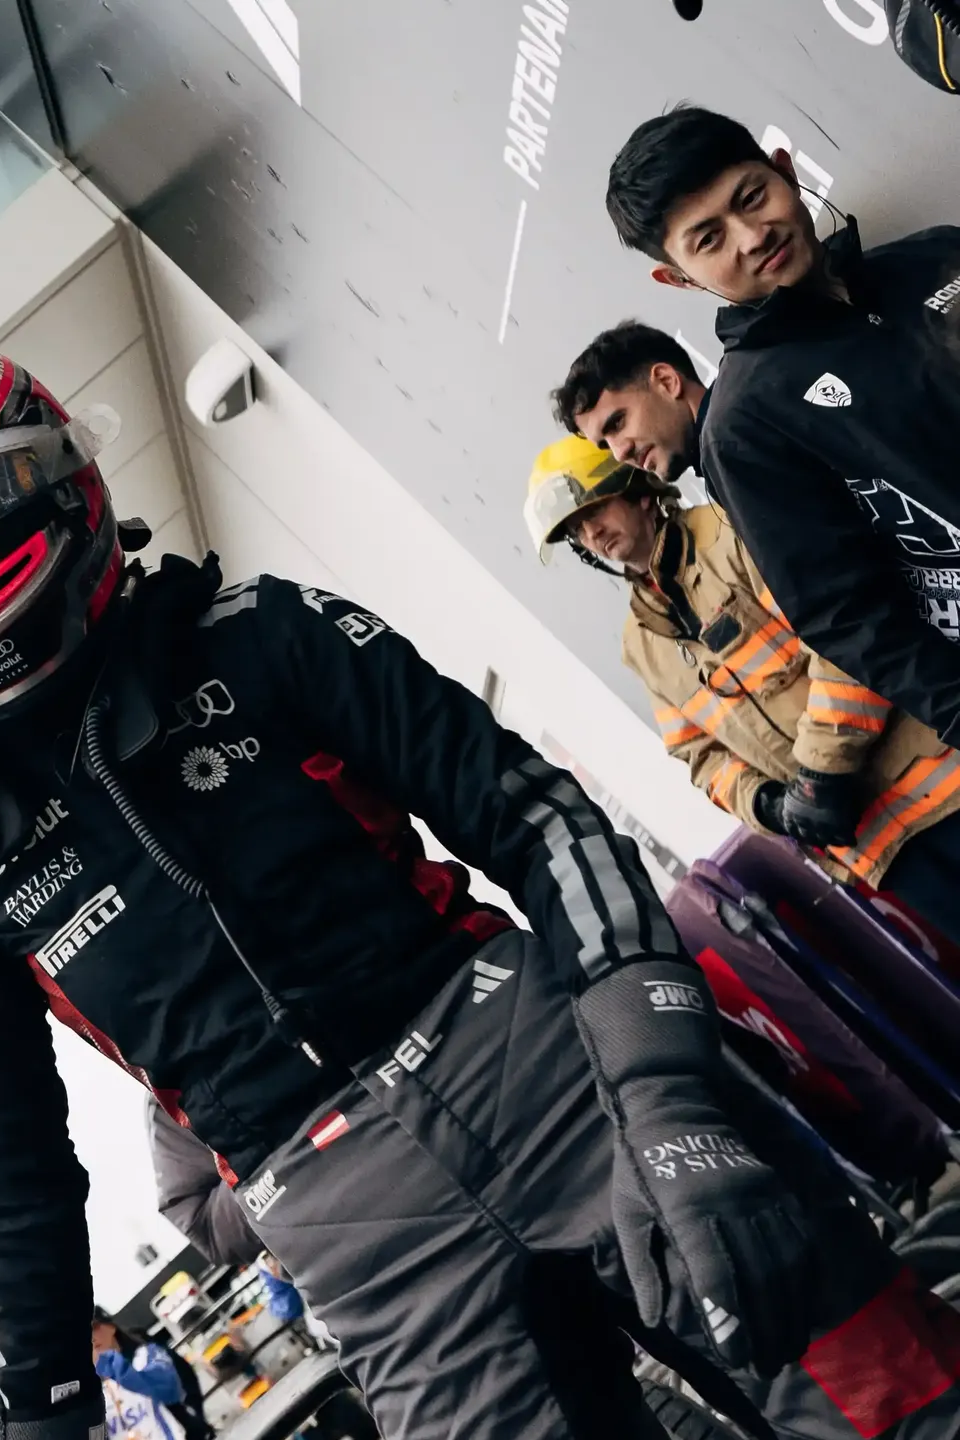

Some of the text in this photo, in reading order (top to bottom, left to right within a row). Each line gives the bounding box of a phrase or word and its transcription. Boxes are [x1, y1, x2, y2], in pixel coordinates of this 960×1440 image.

[218, 736, 261, 762] bp
[3, 846, 78, 915] BAYLIS &
[11, 858, 84, 928] HARDING
[34, 884, 126, 978] PIRELLI
[649, 985, 704, 1010] OMP
[376, 1030, 443, 1088] FEL
[243, 1169, 278, 1214] OMP
[654, 1161, 677, 1180] &
